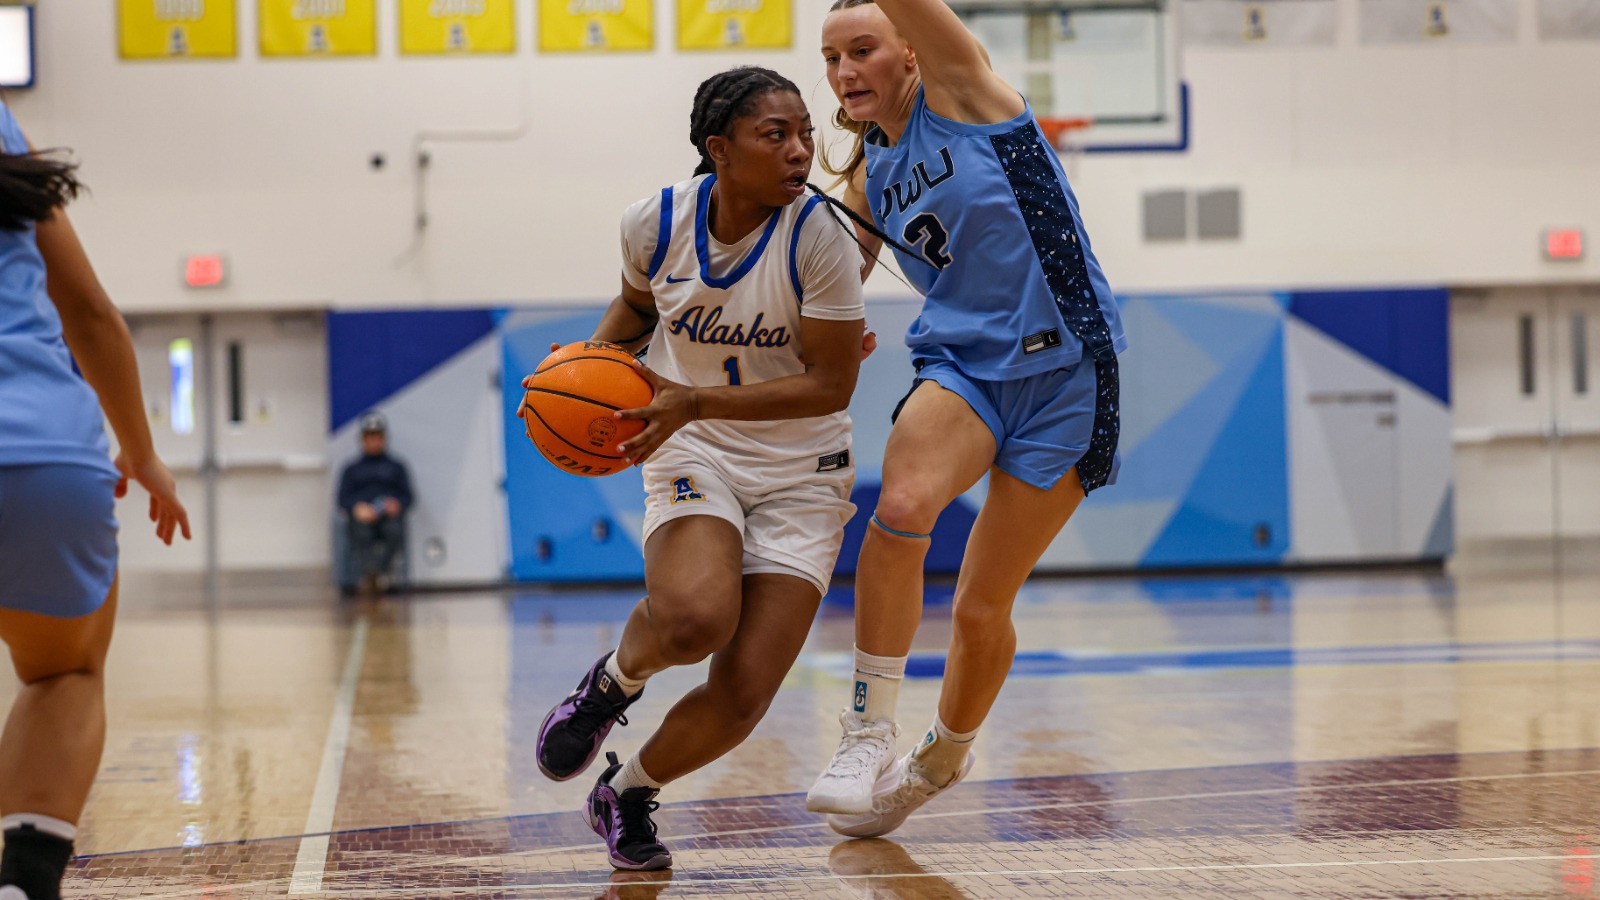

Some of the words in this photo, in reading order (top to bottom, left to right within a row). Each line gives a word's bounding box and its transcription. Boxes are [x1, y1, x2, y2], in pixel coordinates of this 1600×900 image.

[902, 212, 954, 272] 2
[668, 305, 791, 348] Alaska
[722, 354, 743, 386] 1
